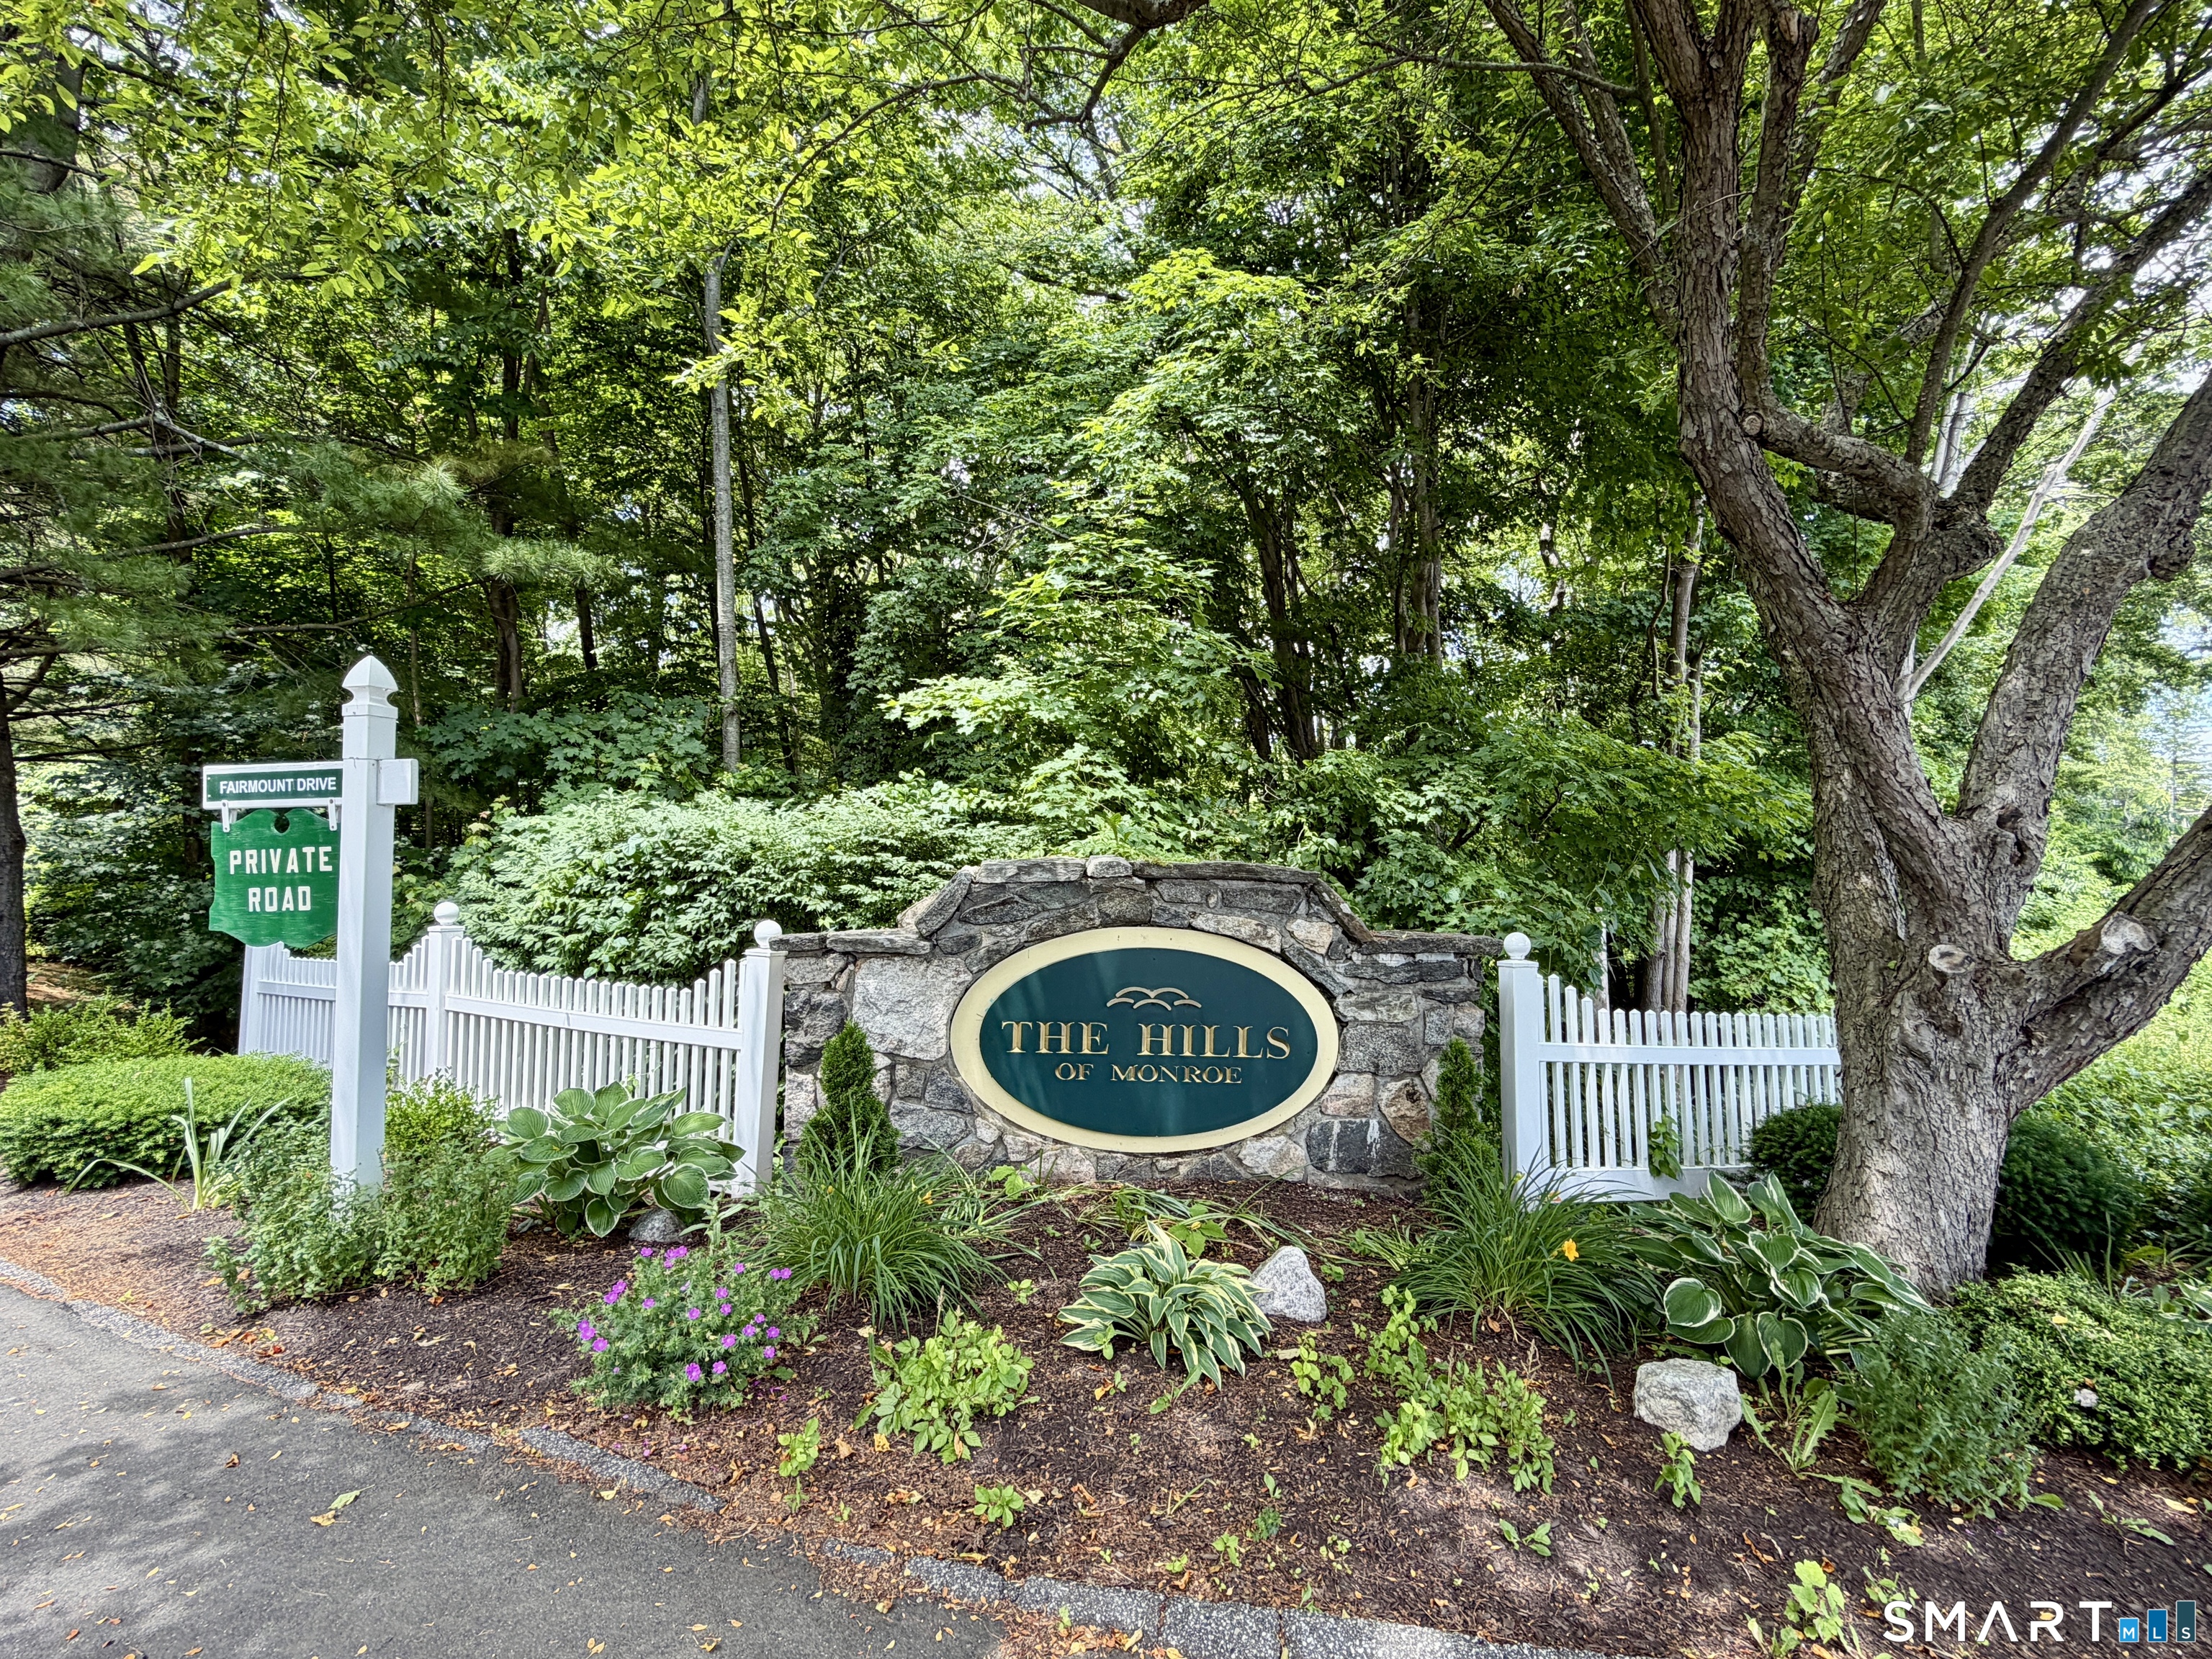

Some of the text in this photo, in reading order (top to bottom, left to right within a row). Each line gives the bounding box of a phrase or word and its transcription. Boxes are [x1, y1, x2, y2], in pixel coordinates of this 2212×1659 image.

[220, 777, 336, 794] FAIRMOUNT DRIVE
[229, 846, 333, 875] PRIVATE
[248, 886, 311, 912] ROAD
[1002, 1020, 1291, 1059] THE HILLS
[1054, 1062, 1243, 1084] OF MONROE
